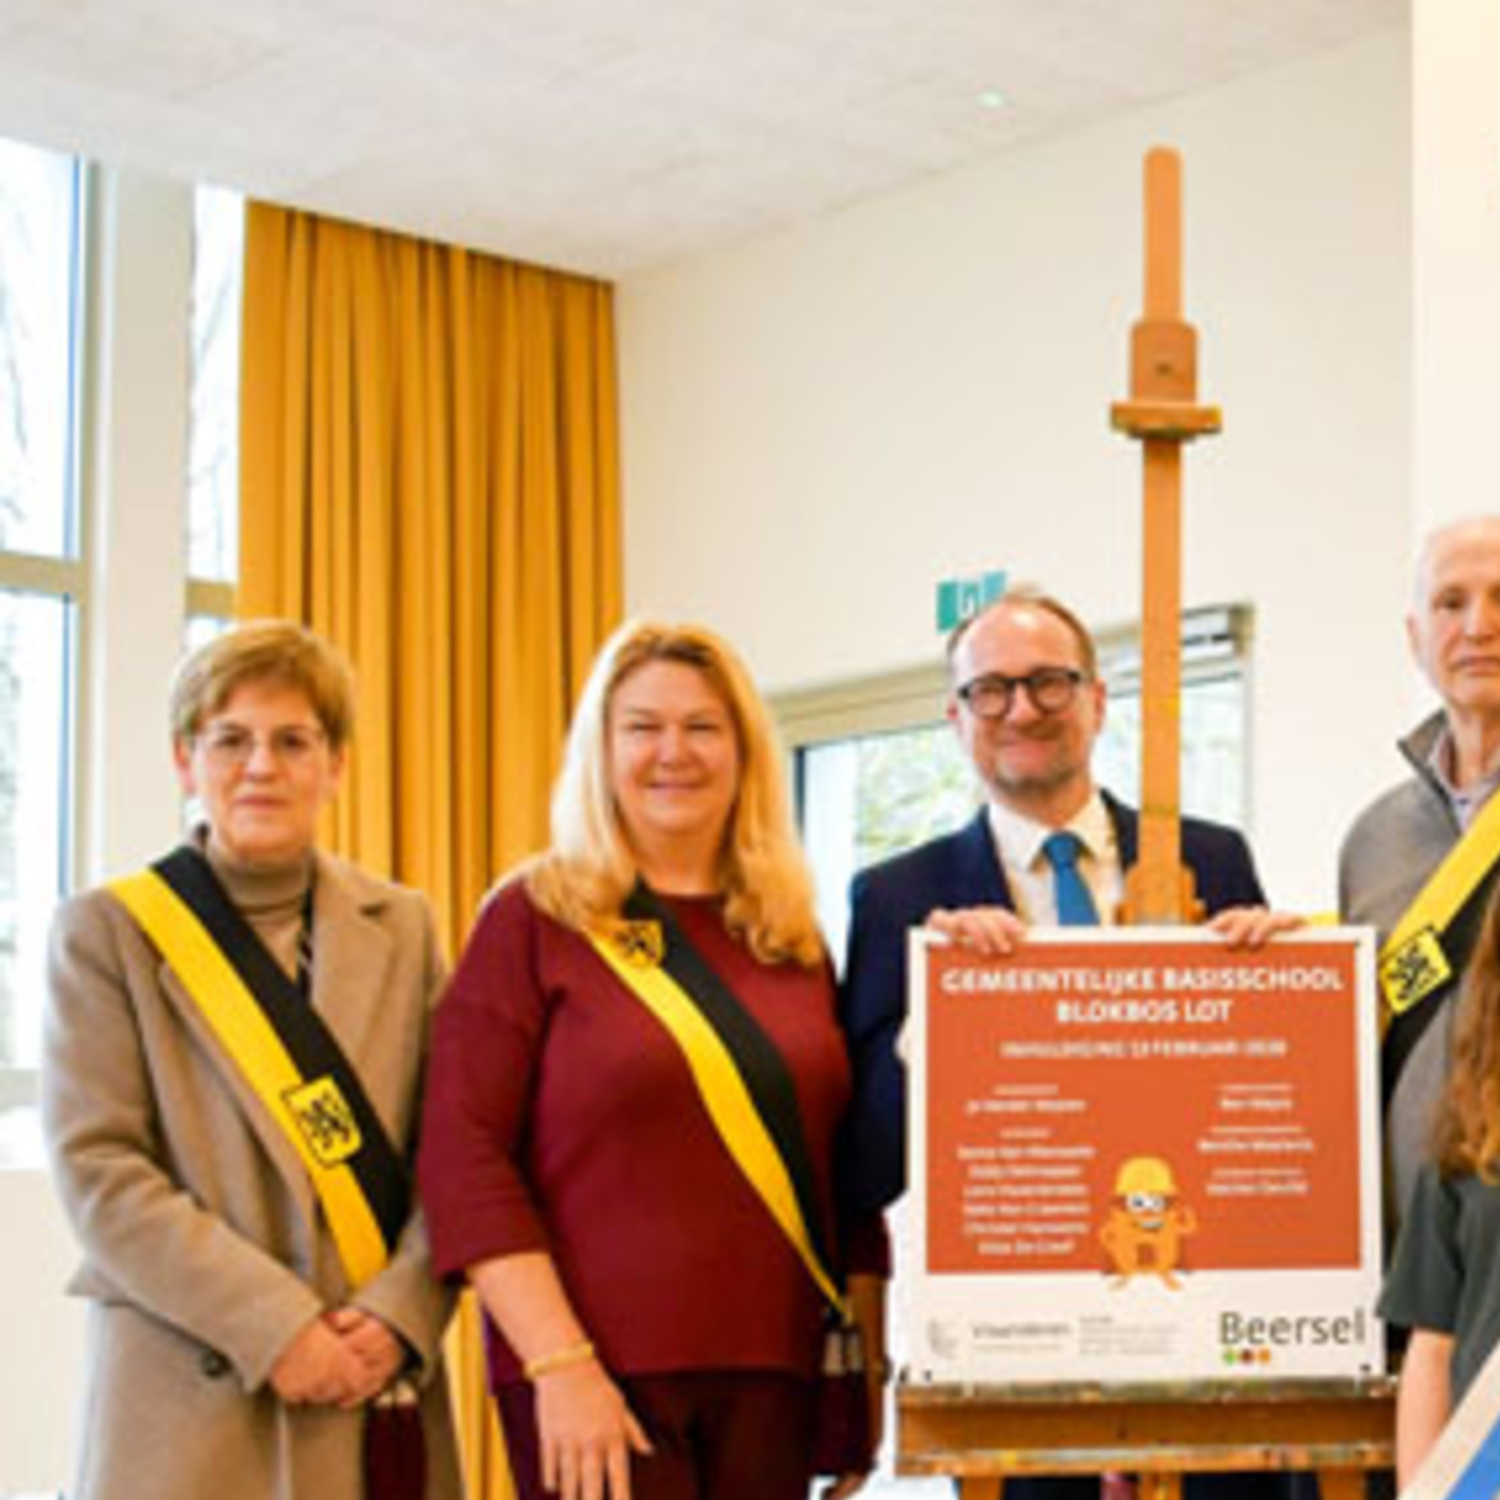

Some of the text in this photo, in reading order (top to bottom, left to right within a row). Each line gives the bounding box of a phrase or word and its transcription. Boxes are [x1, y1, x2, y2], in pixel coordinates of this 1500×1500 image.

[941, 966, 1344, 994] GEMEENTELIJKE BASISSCHOOL
[1055, 999, 1232, 1023] BLOKBOS LOT
[1219, 1307, 1366, 1344] Beersel
